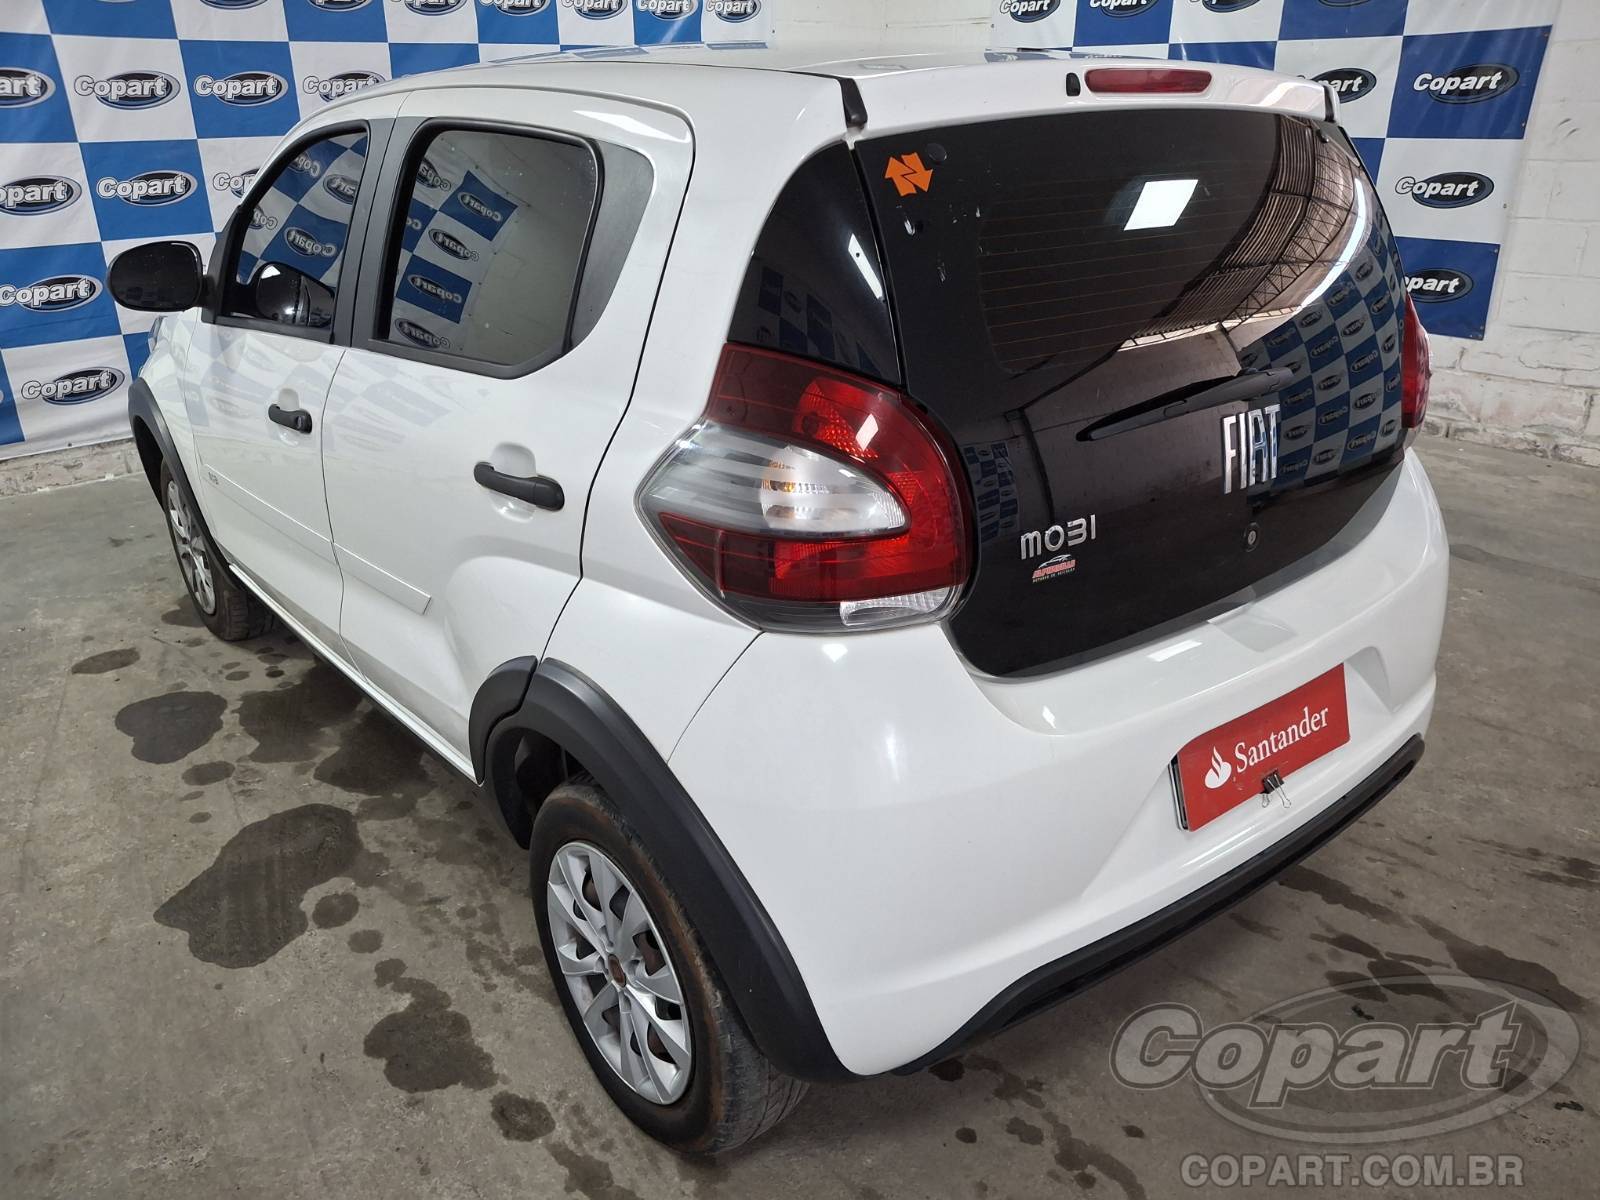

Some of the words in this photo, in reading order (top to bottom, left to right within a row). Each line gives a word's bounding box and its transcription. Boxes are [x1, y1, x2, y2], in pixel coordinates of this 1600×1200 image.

[636, 0, 690, 15] Copart
[706, 0, 754, 14] Copart
[999, 0, 1050, 15] Copart
[0, 74, 41, 97] art
[74, 75, 168, 100] Copart
[194, 75, 278, 100] Copart
[1319, 76, 1362, 92] art
[1413, 72, 1502, 94] Copart
[0, 181, 67, 208] part
[97, 175, 187, 199] Copart
[1395, 176, 1480, 198] Copart
[0, 278, 91, 306] Copart
[1405, 277, 1460, 293] part
[21, 370, 114, 400] Copart
[1222, 404, 1280, 494] FIAT
[1020, 514, 1097, 560] MOBI
[1234, 705, 1329, 774] Santander
